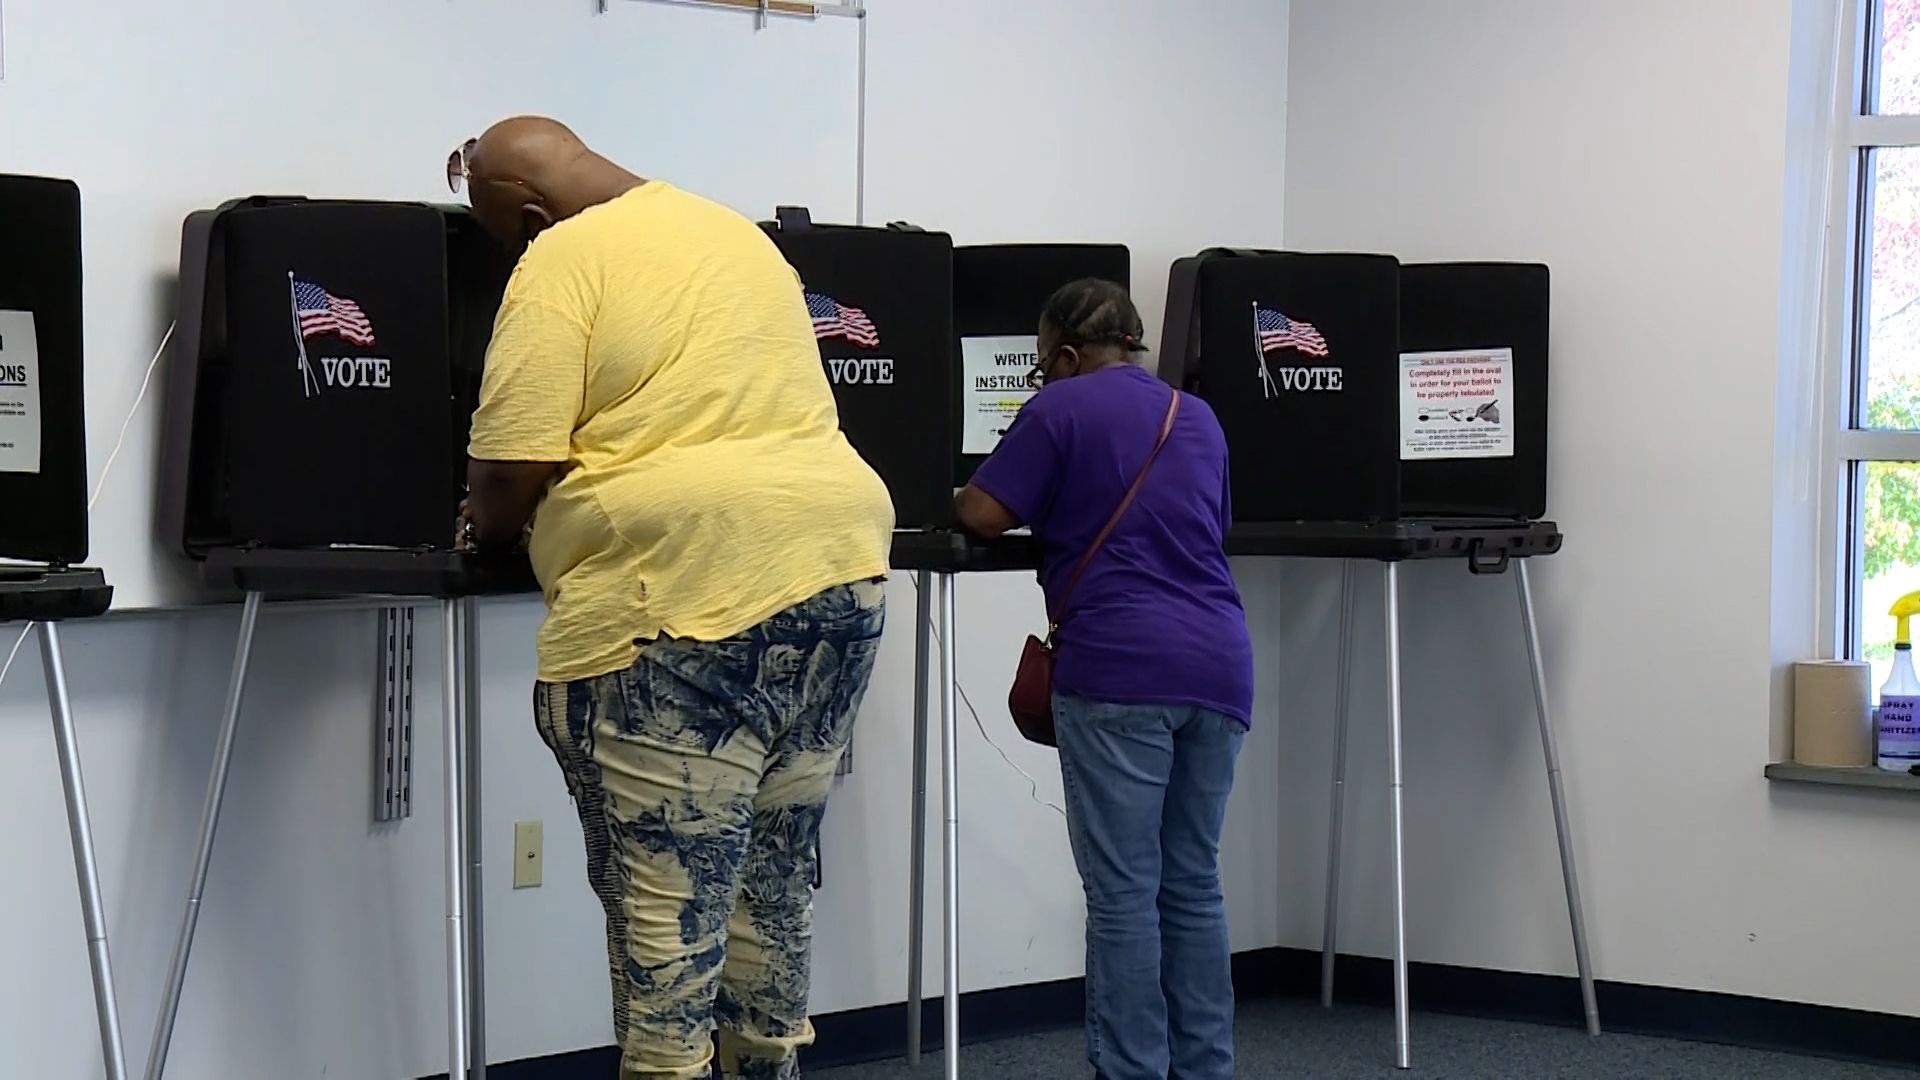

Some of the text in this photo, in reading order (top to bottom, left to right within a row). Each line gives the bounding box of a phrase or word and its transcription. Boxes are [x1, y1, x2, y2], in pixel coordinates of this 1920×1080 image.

[321, 357, 391, 388] VOTE
[828, 358, 894, 385] VOTE
[1279, 367, 1343, 391] VOTE
[1409, 369, 1451, 378] Completely
[1452, 368, 1462, 376] fill
[1419, 380, 1439, 388] order
[1440, 379, 1451, 387] for
[1452, 380, 1470, 388] your
[1471, 378, 1492, 386] ballot
